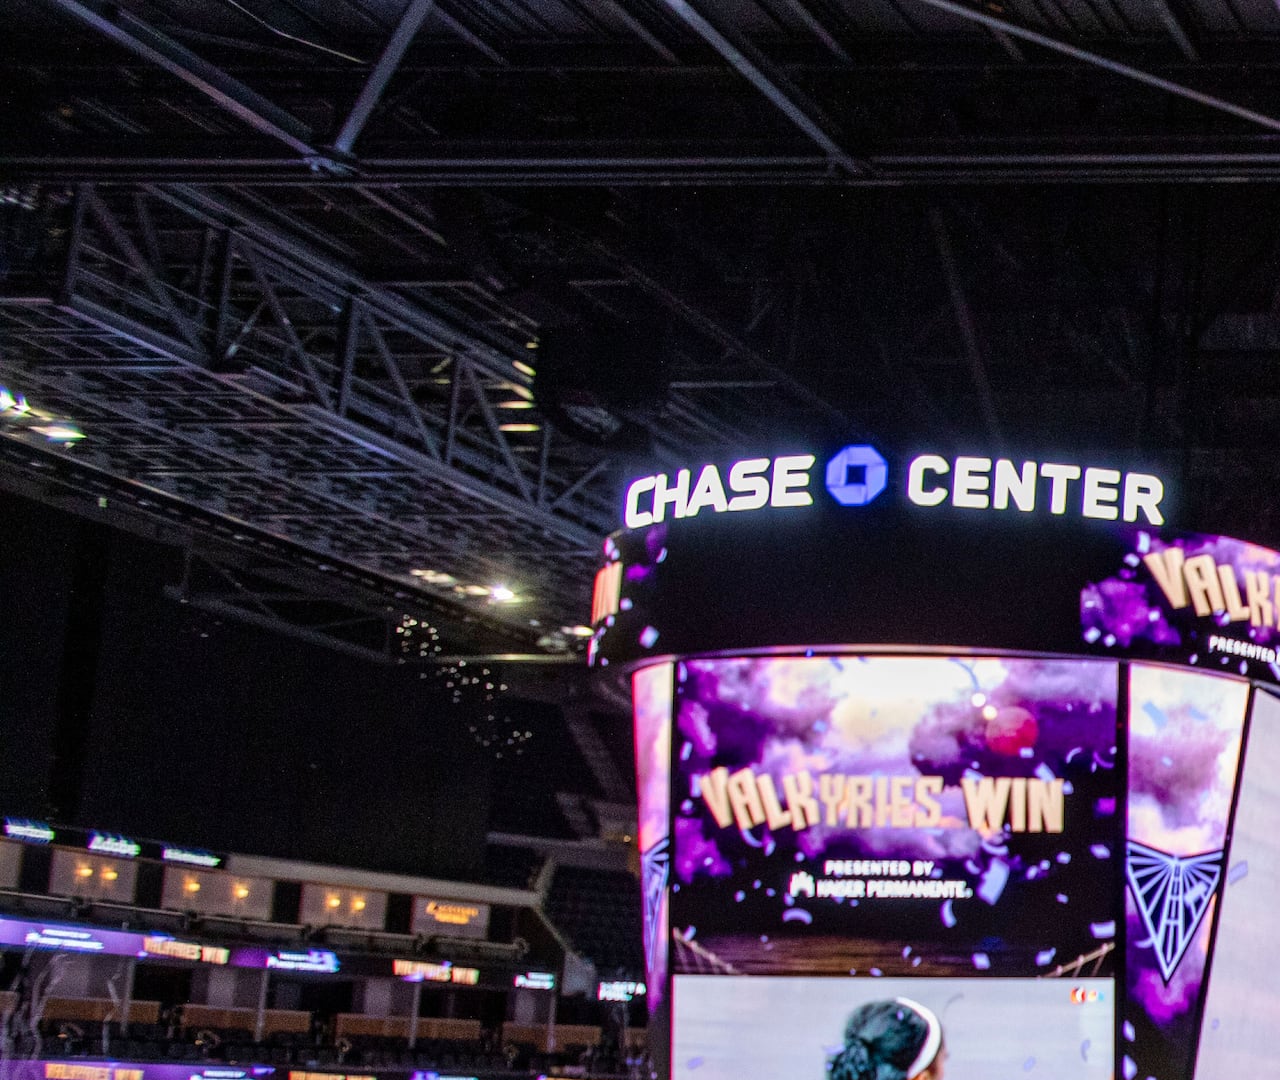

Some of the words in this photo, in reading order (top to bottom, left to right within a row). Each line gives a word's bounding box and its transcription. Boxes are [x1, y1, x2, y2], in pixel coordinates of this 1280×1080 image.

[625, 455, 815, 529] CHASE
[907, 455, 1164, 525] CENTER
[702, 767, 944, 832] VALKYRIES
[961, 777, 1065, 834] WIN
[824, 859, 911, 877] PRESENTED
[912, 859, 935, 877] BY
